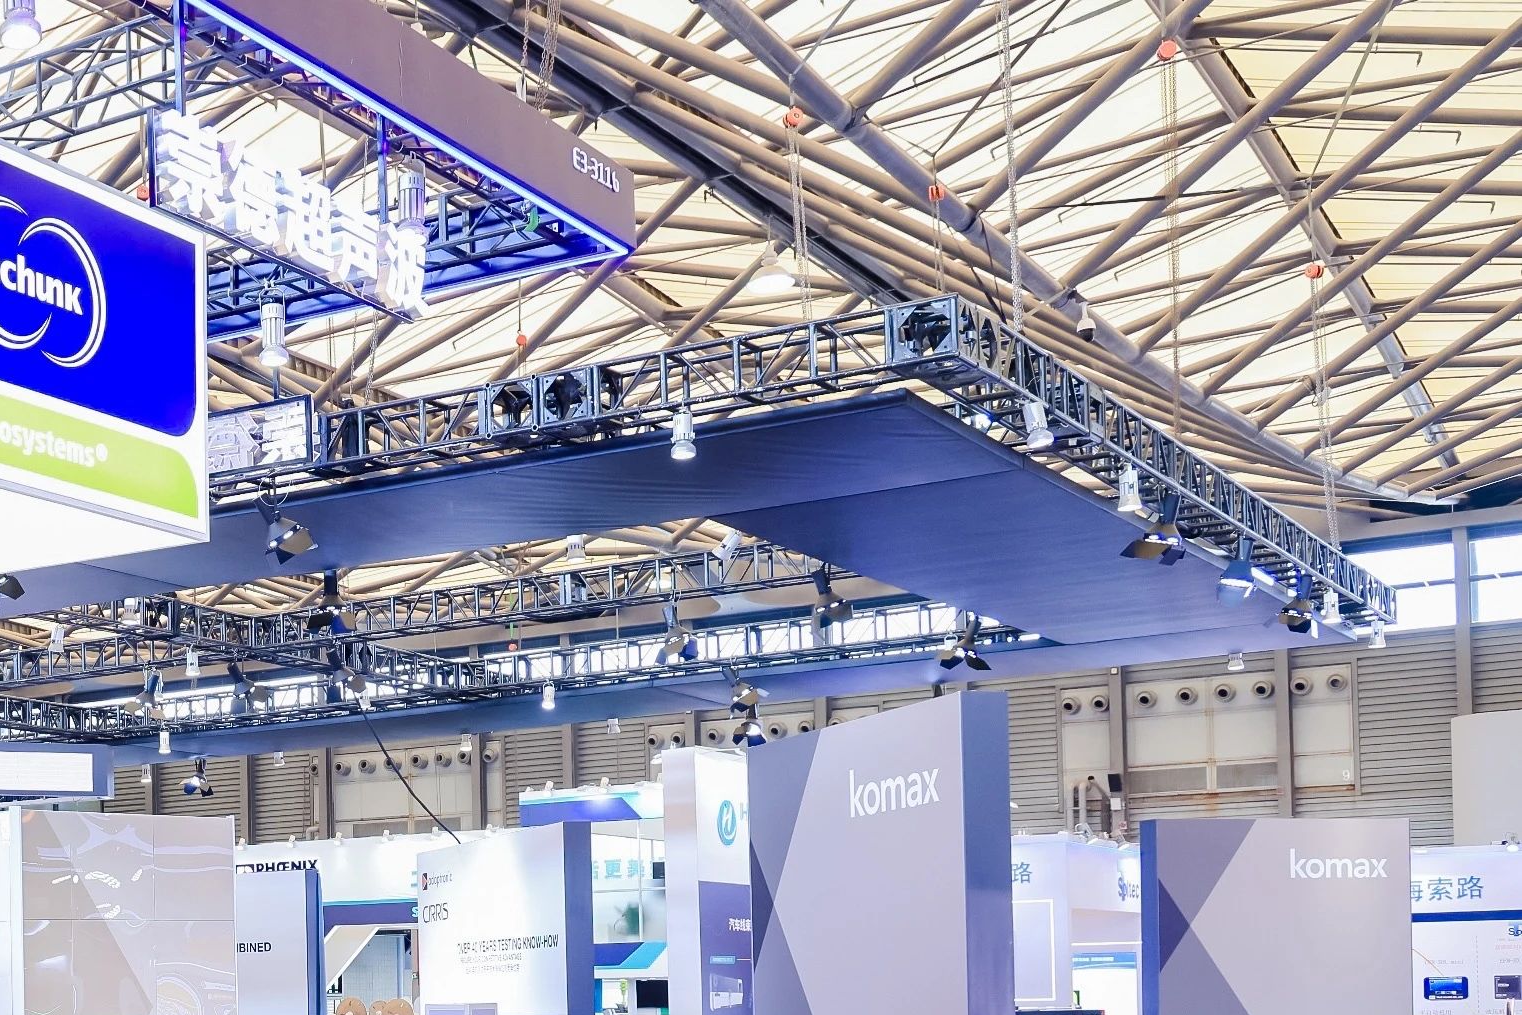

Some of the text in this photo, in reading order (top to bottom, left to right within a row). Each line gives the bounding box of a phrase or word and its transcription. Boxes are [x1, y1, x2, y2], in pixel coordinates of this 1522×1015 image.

[572, 146, 620, 193] E3-3116
[848, 766, 941, 818] komax
[1289, 848, 1389, 880] komax
[236, 941, 272, 953] BINED
[497, 936, 522, 951] TESTING
[522, 933, 559, 950] KNOW-HOW
